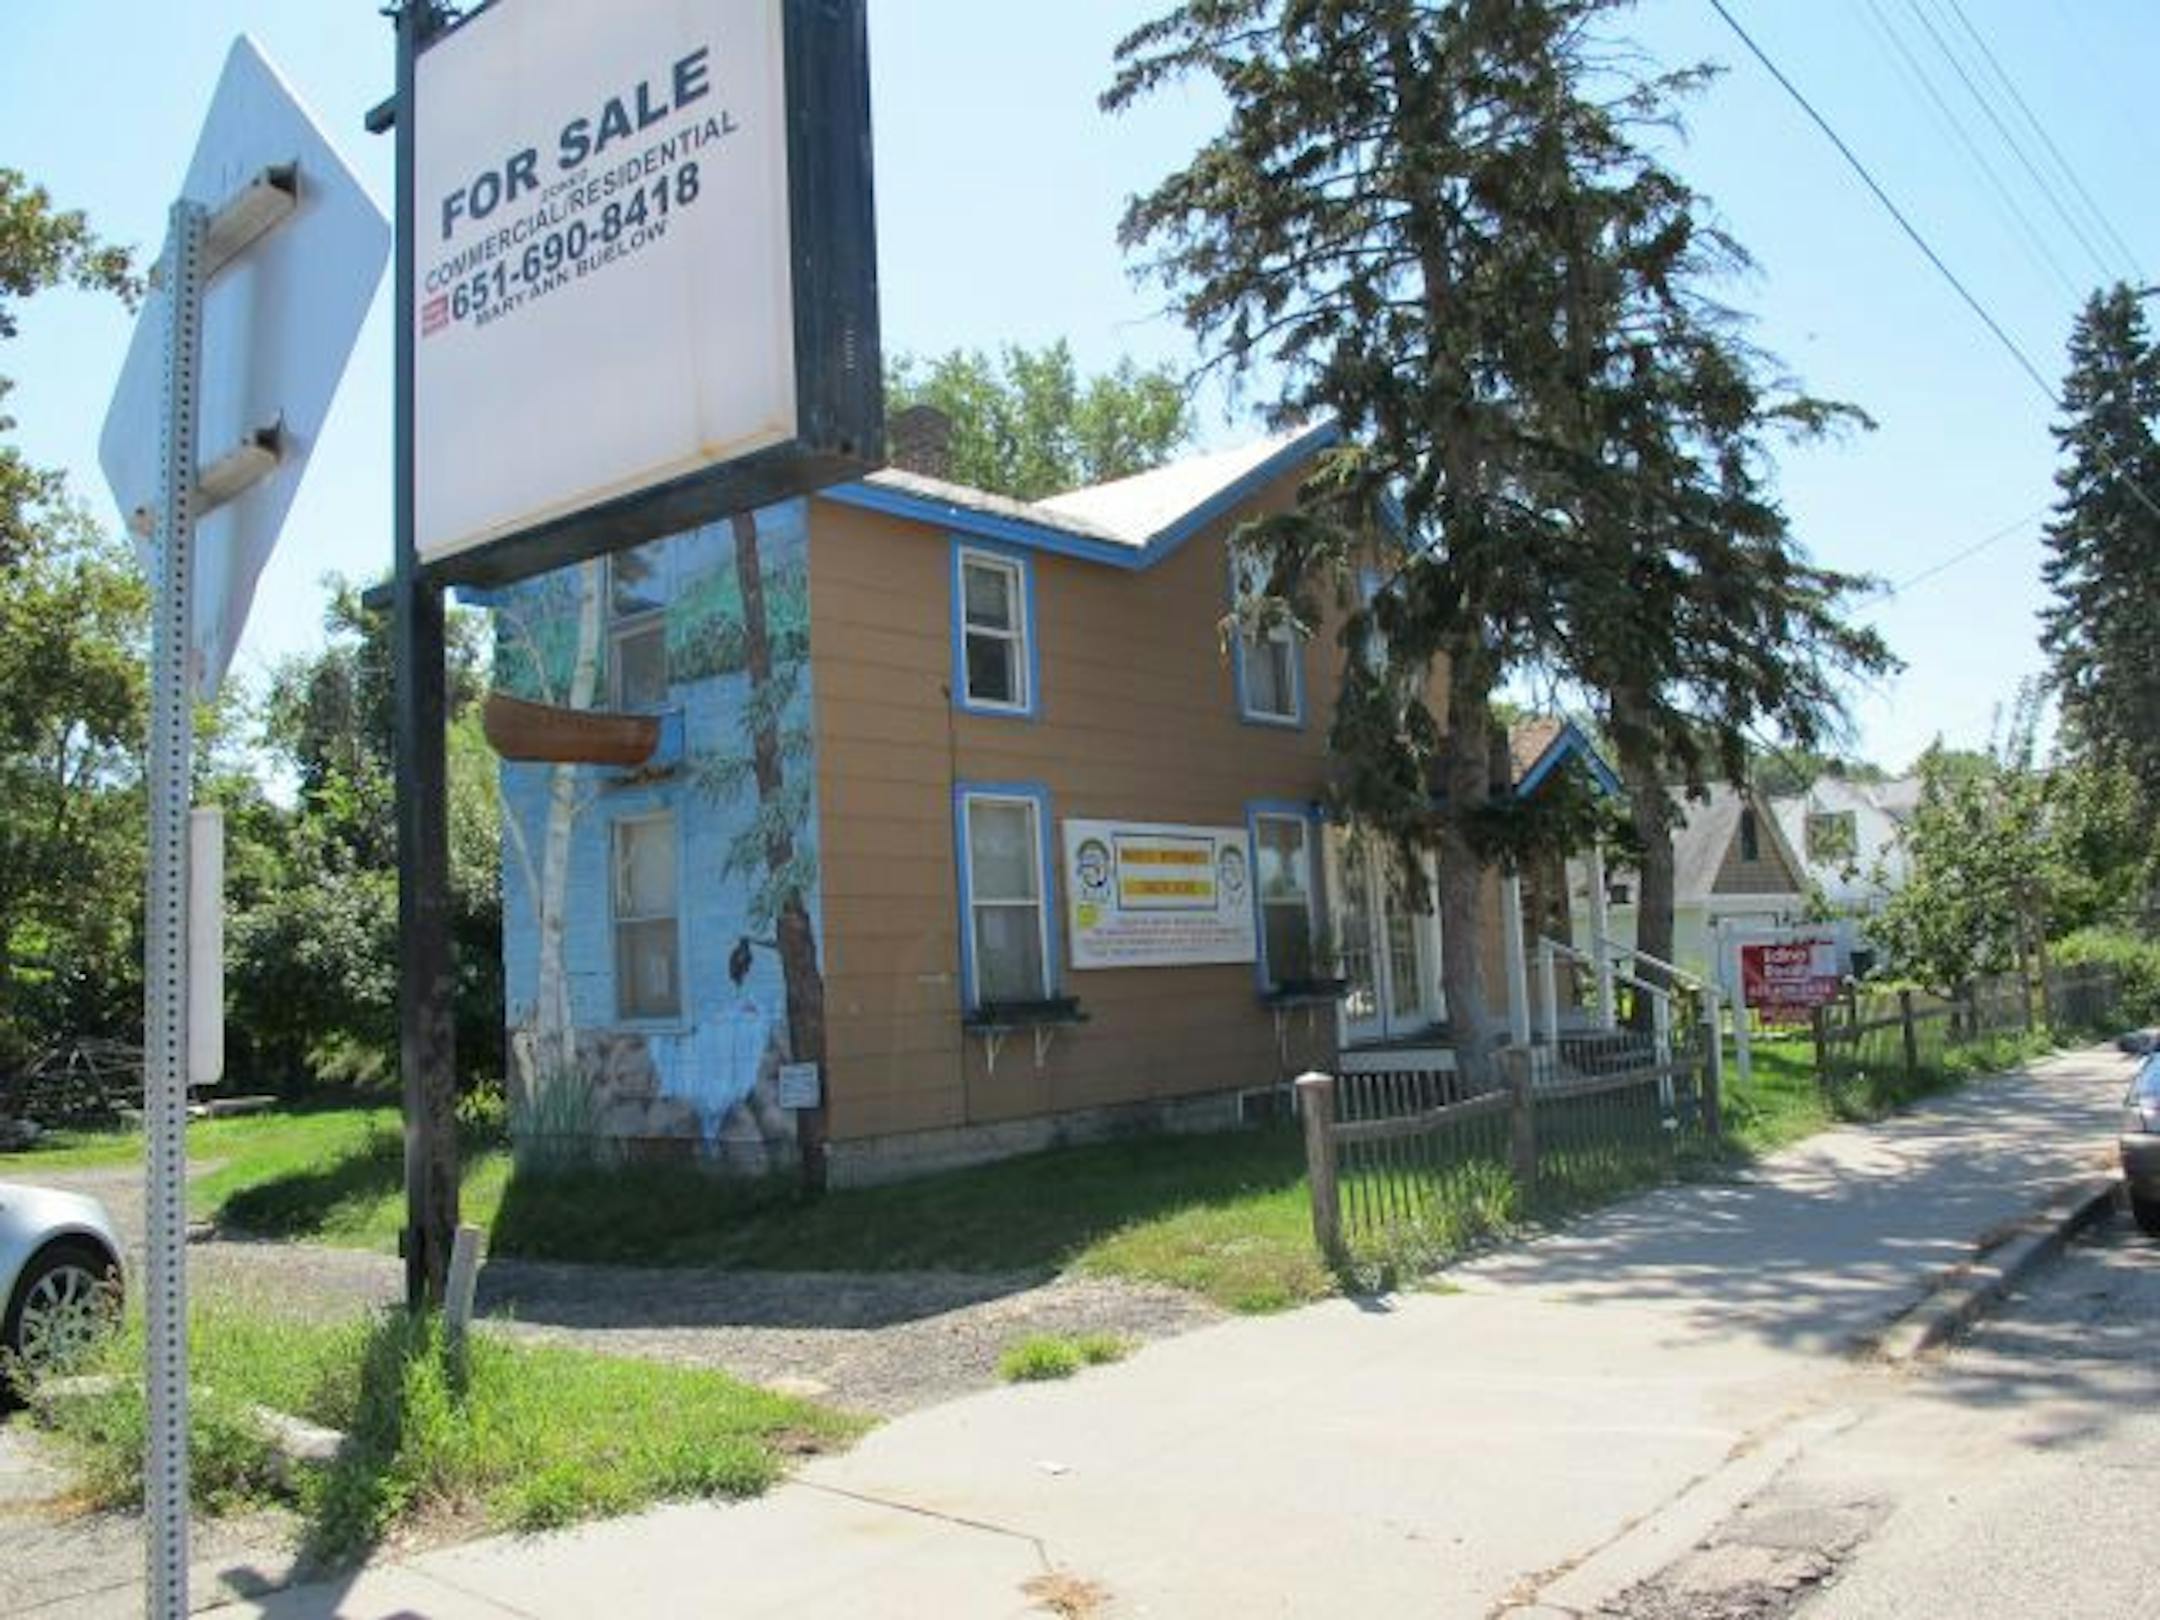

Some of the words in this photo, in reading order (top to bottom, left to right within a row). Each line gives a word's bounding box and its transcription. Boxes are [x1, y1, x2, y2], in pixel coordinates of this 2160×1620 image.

[424, 110, 738, 294] COMMERCIAL/RESIDENTIAL
[442, 148, 539, 241] FOR
[558, 47, 709, 169] SALE
[452, 162, 699, 320] 651-690-8418
[475, 292, 526, 326] MARY
[529, 268, 569, 298] ANN
